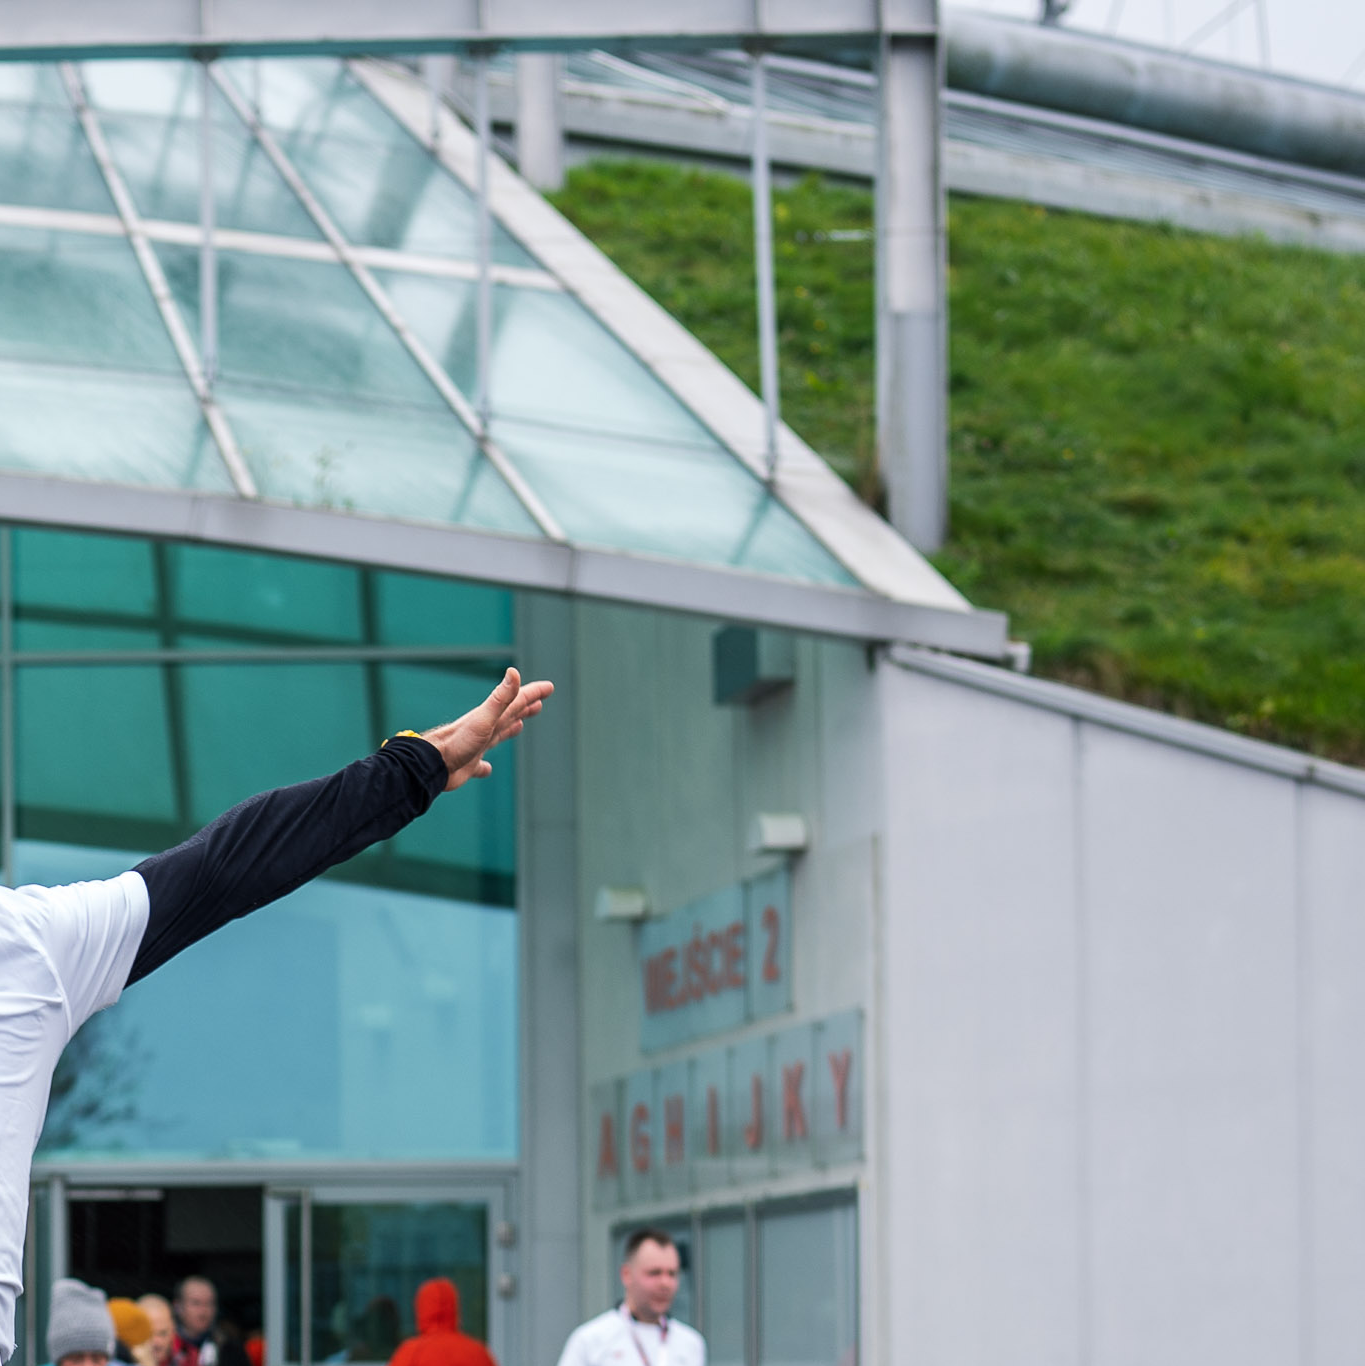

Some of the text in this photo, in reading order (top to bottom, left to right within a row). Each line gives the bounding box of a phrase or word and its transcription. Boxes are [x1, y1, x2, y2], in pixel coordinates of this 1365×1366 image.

[762, 905, 779, 982] 2
[597, 1048, 852, 1180] A G H I J K Y
